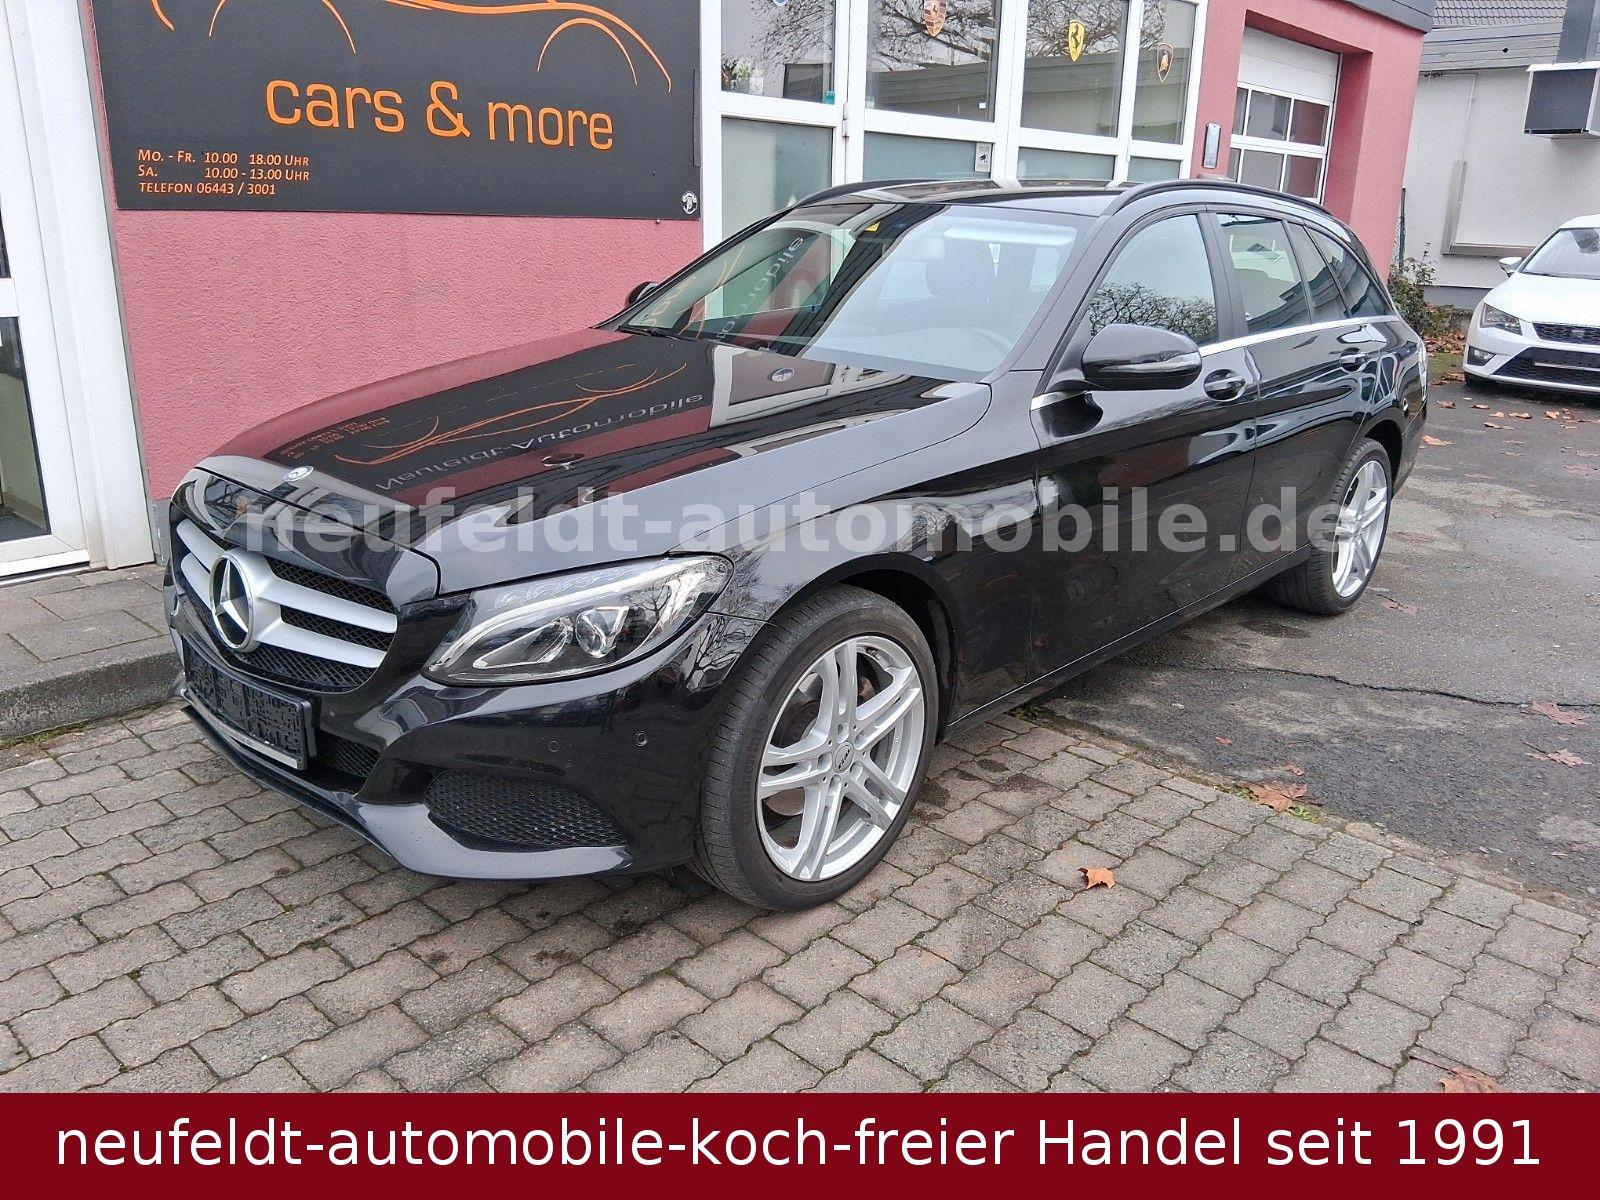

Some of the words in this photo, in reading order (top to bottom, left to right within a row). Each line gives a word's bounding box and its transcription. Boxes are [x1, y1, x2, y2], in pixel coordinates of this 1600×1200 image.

[266, 80, 405, 133] cars
[426, 80, 471, 138] &
[488, 101, 613, 150] more
[138, 149, 164, 162] MO.
[177, 150, 196, 163] FR.
[204, 152, 238, 164] 10.00
[249, 154, 281, 166] 18.00
[285, 155, 309, 166] UHR
[138, 164, 158, 177] SA.
[204, 167, 238, 179] 10.00
[250, 169, 282, 180] 13.00
[285, 169, 310, 181] UHR
[140, 182, 192, 193] TELEFON
[197, 183, 234, 194] 06443
[237, 181, 244, 196] /
[247, 183, 275, 195] 3001
